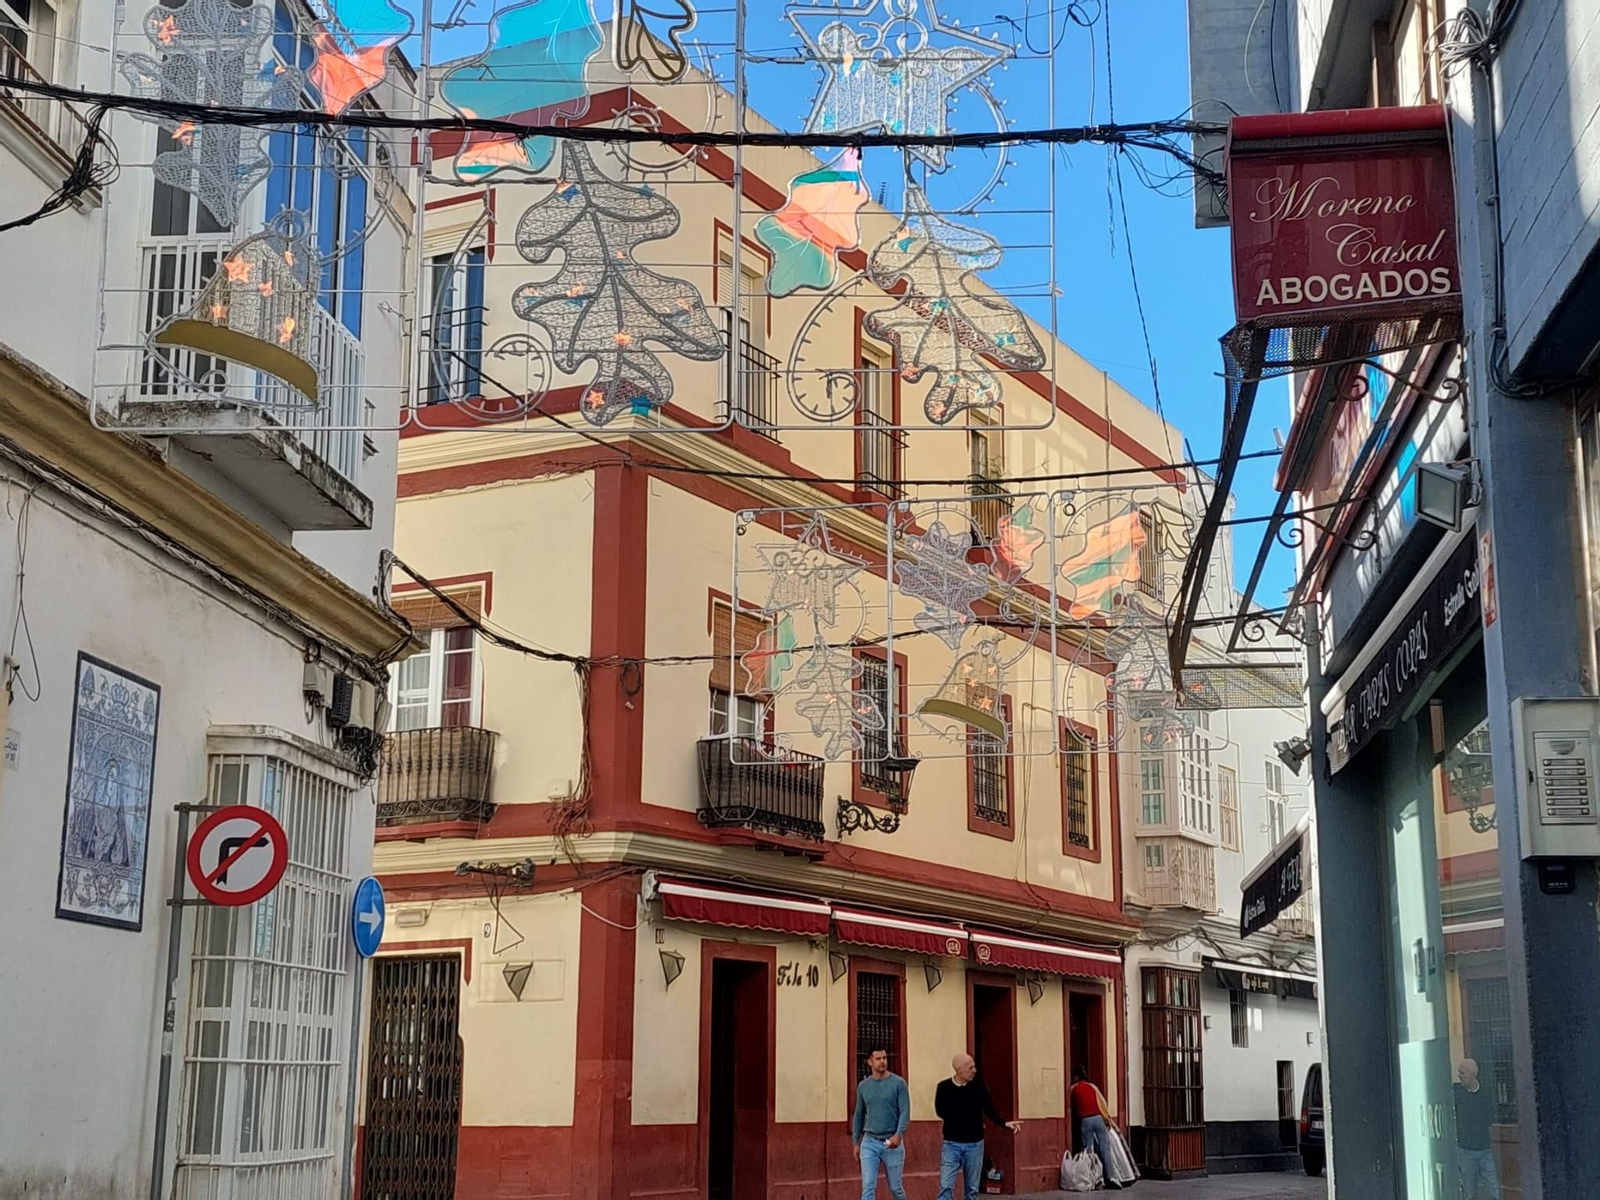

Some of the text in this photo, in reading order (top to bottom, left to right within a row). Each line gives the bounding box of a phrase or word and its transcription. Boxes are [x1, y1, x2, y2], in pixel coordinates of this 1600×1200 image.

[1249, 176, 1418, 223] Moreno
[1325, 223, 1447, 267] Casal
[1256, 267, 1451, 306] ABOGADOS
[1338, 611, 1429, 753] BAR TAPAS COPAS
[806, 963, 819, 988] 10
